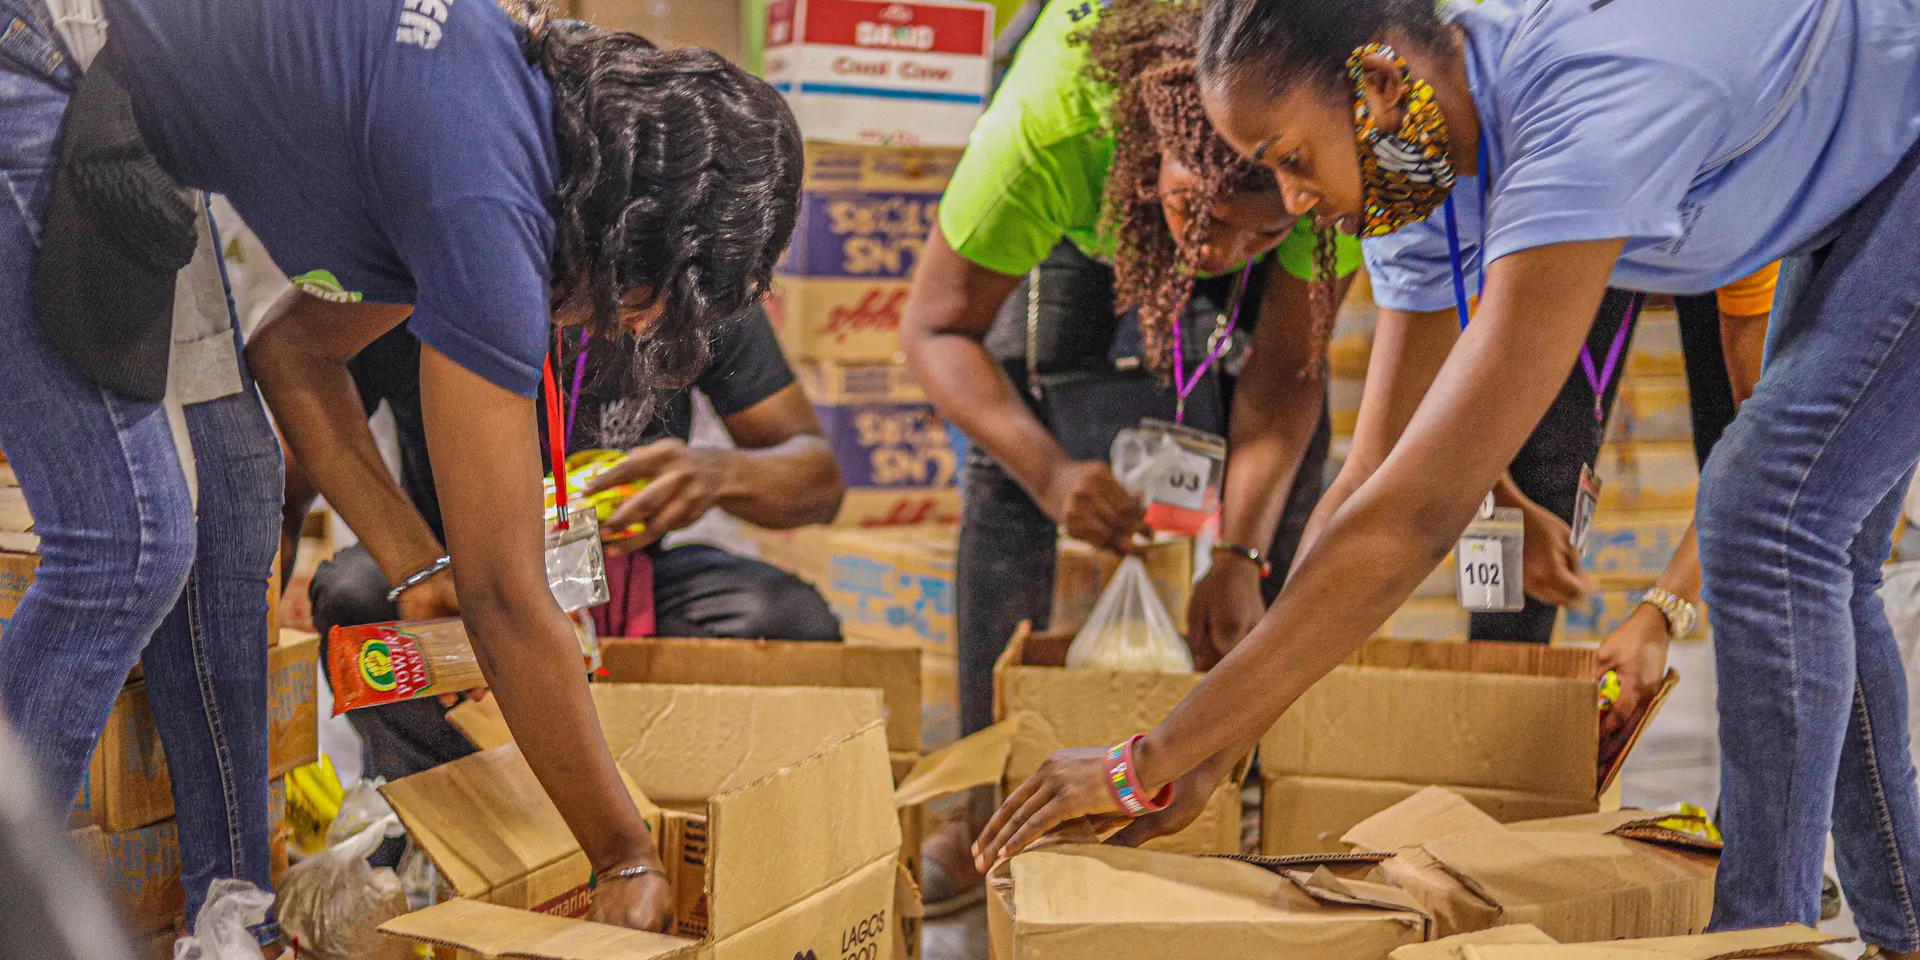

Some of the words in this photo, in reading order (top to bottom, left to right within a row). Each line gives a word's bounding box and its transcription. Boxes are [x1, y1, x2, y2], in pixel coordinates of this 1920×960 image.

[1464, 562, 1501, 586] 102
[384, 635, 412, 696] POWER
[841, 909, 885, 954] LAGOS
